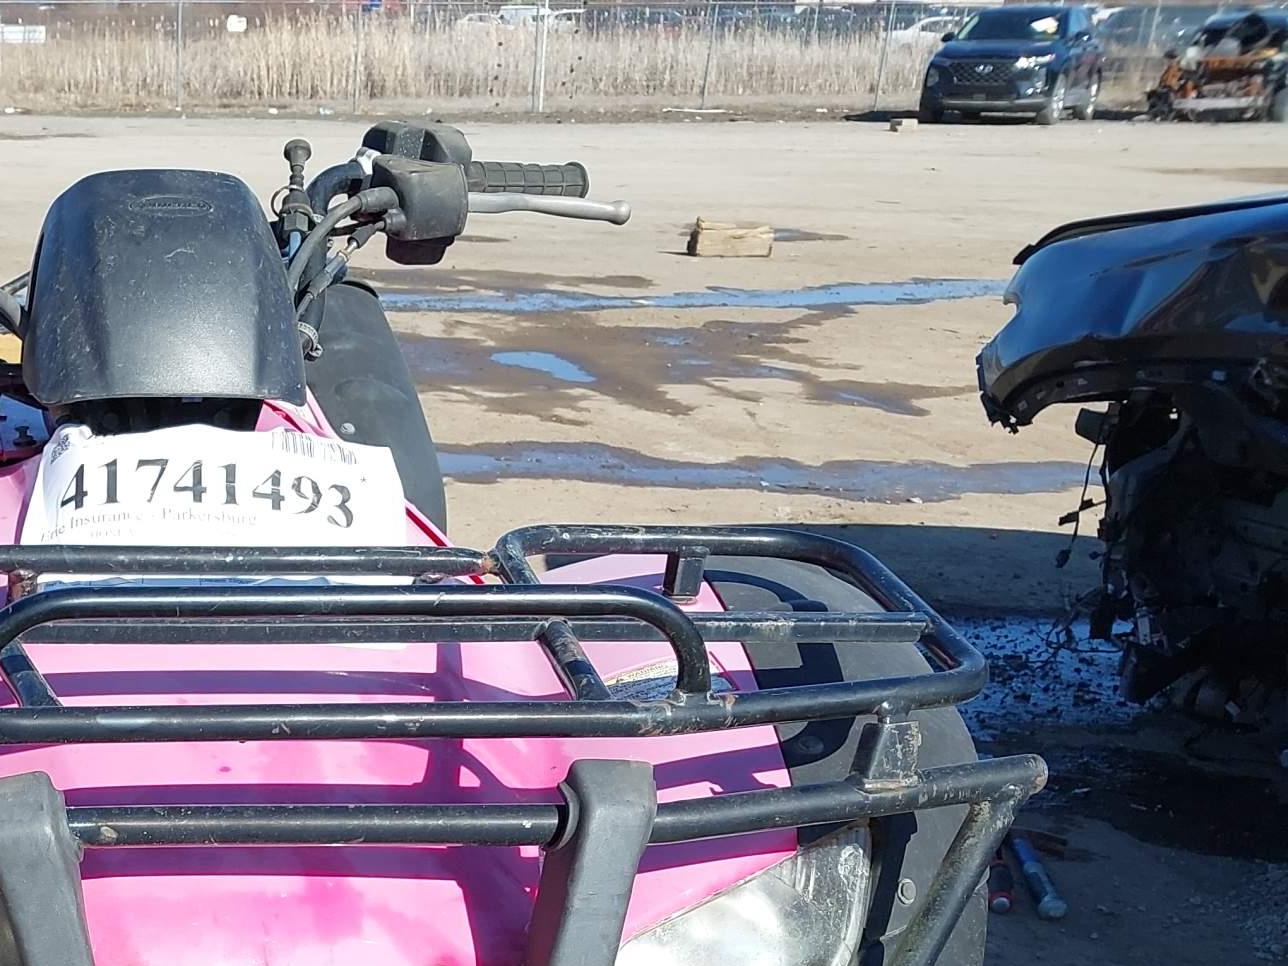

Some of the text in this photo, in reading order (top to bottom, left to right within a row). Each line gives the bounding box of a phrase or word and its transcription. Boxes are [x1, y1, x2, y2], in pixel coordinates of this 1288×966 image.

[60, 458, 354, 529] 41741493
[69, 509, 144, 529] Insurance
[160, 506, 257, 526] Parkersburg
